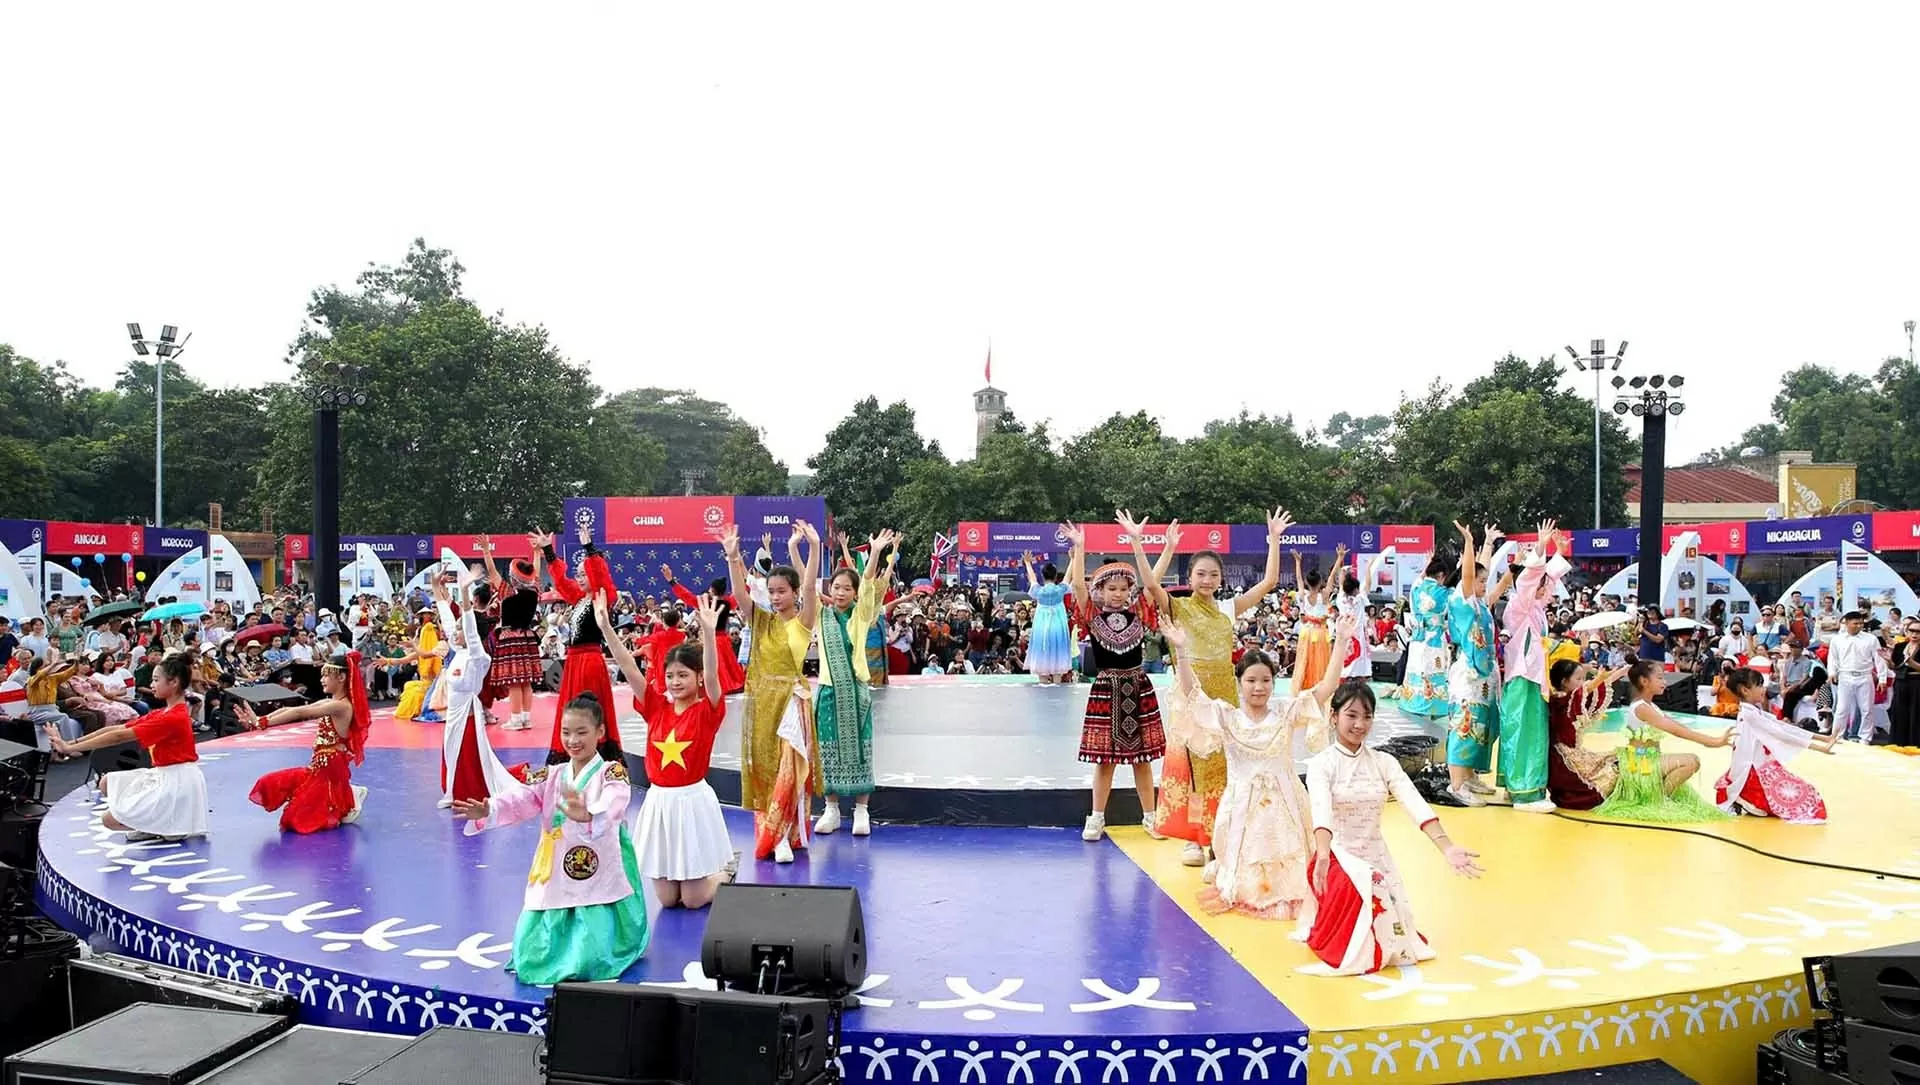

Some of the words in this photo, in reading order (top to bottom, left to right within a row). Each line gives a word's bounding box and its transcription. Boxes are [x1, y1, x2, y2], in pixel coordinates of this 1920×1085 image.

[633, 515, 664, 526] CHINA
[763, 515, 789, 525] INDIA
[73, 534, 107, 545] ANGOLA
[1766, 529, 1822, 543] NICARAGUA
[161, 537, 193, 548] MOROCCO
[339, 543, 356, 551] UDI
[1592, 538, 1609, 548] PERU
